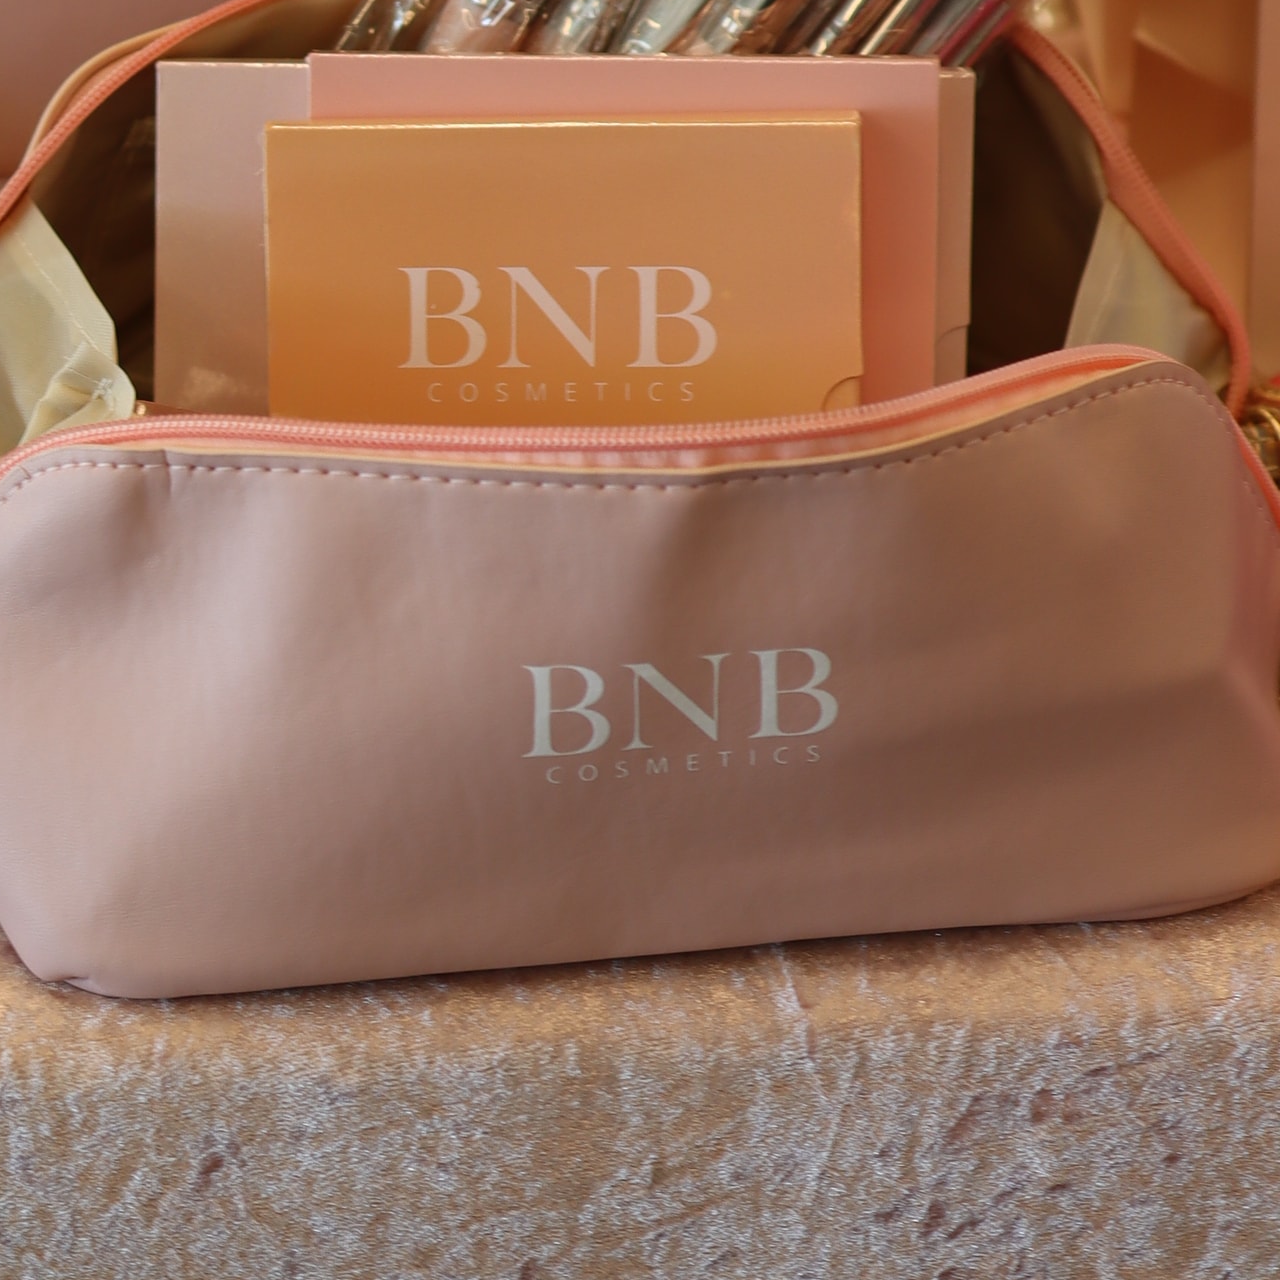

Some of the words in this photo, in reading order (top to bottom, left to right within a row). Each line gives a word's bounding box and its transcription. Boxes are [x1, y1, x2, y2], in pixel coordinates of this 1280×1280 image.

[397, 266, 718, 368] BNB
[426, 382, 696, 403] COSMETICS
[521, 648, 839, 757] BNB
[545, 745, 821, 784] COSMETICS
